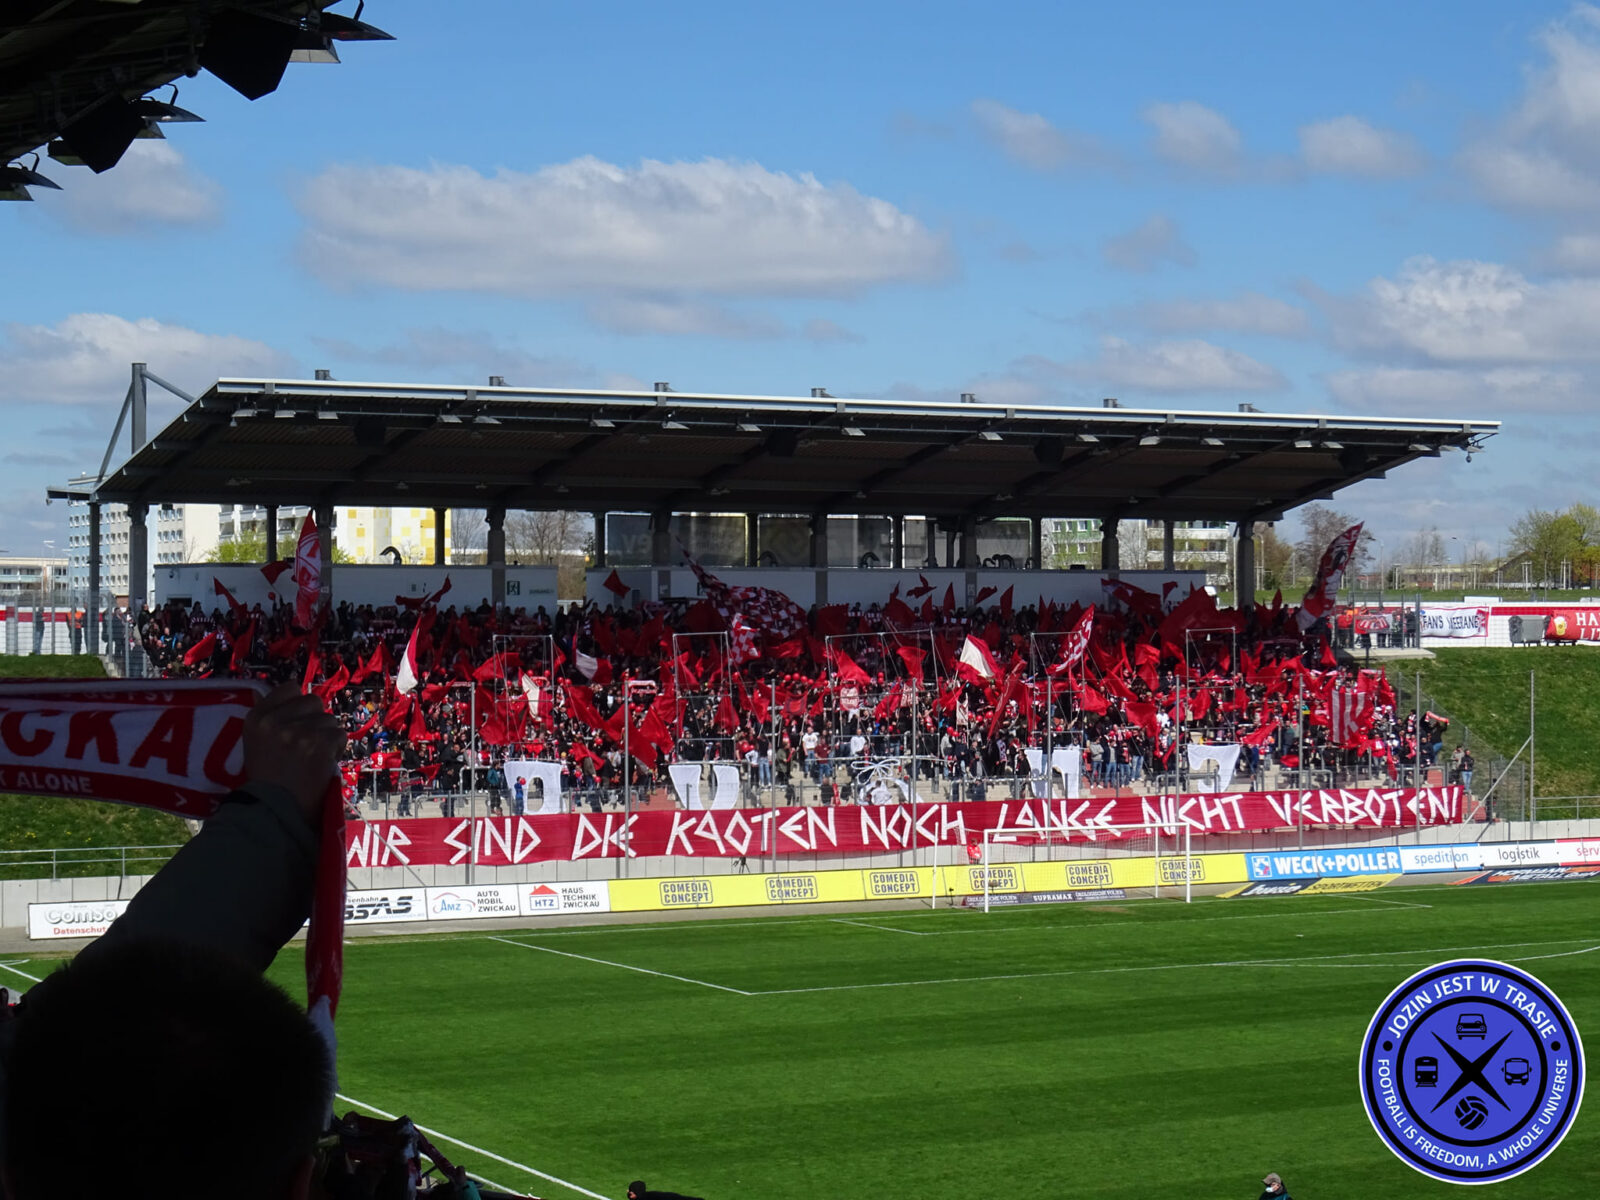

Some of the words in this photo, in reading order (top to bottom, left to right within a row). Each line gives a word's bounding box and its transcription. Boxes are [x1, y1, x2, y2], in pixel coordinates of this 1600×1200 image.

[1576, 612, 1600, 626] HA
[0, 706, 246, 787] CKAU
[17, 771, 93, 793] ALONE
[347, 823, 412, 867] WIR
[444, 817, 542, 864] SIND
[572, 813, 640, 860] DIE
[665, 806, 838, 855] KAOTEN
[860, 804, 966, 849] NOCH
[992, 799, 1122, 843] LANGE
[1141, 794, 1246, 835] NICHT
[1266, 786, 1459, 826] VERBOTEN!
[1414, 851, 1469, 866] spedition
[1498, 847, 1540, 863] logistik
[1161, 860, 1202, 870] COMEDIA
[1274, 853, 1400, 875] WECK+POLLER
[1069, 865, 1109, 875] COMEDIA
[1163, 869, 1203, 880] CONCEPT
[768, 877, 814, 887] COMEDIA
[872, 873, 916, 883] COMEDIA
[1070, 875, 1110, 885] CONCEPT
[663, 883, 709, 893] COMEDIA
[769, 886, 815, 898] CONCEPT
[873, 883, 917, 894] CONCEPT
[346, 896, 379, 904] senbahn
[664, 892, 710, 903] CONCEPT
[1033, 893, 1073, 901] SUPRAMAX
[534, 899, 555, 907] HTZ
